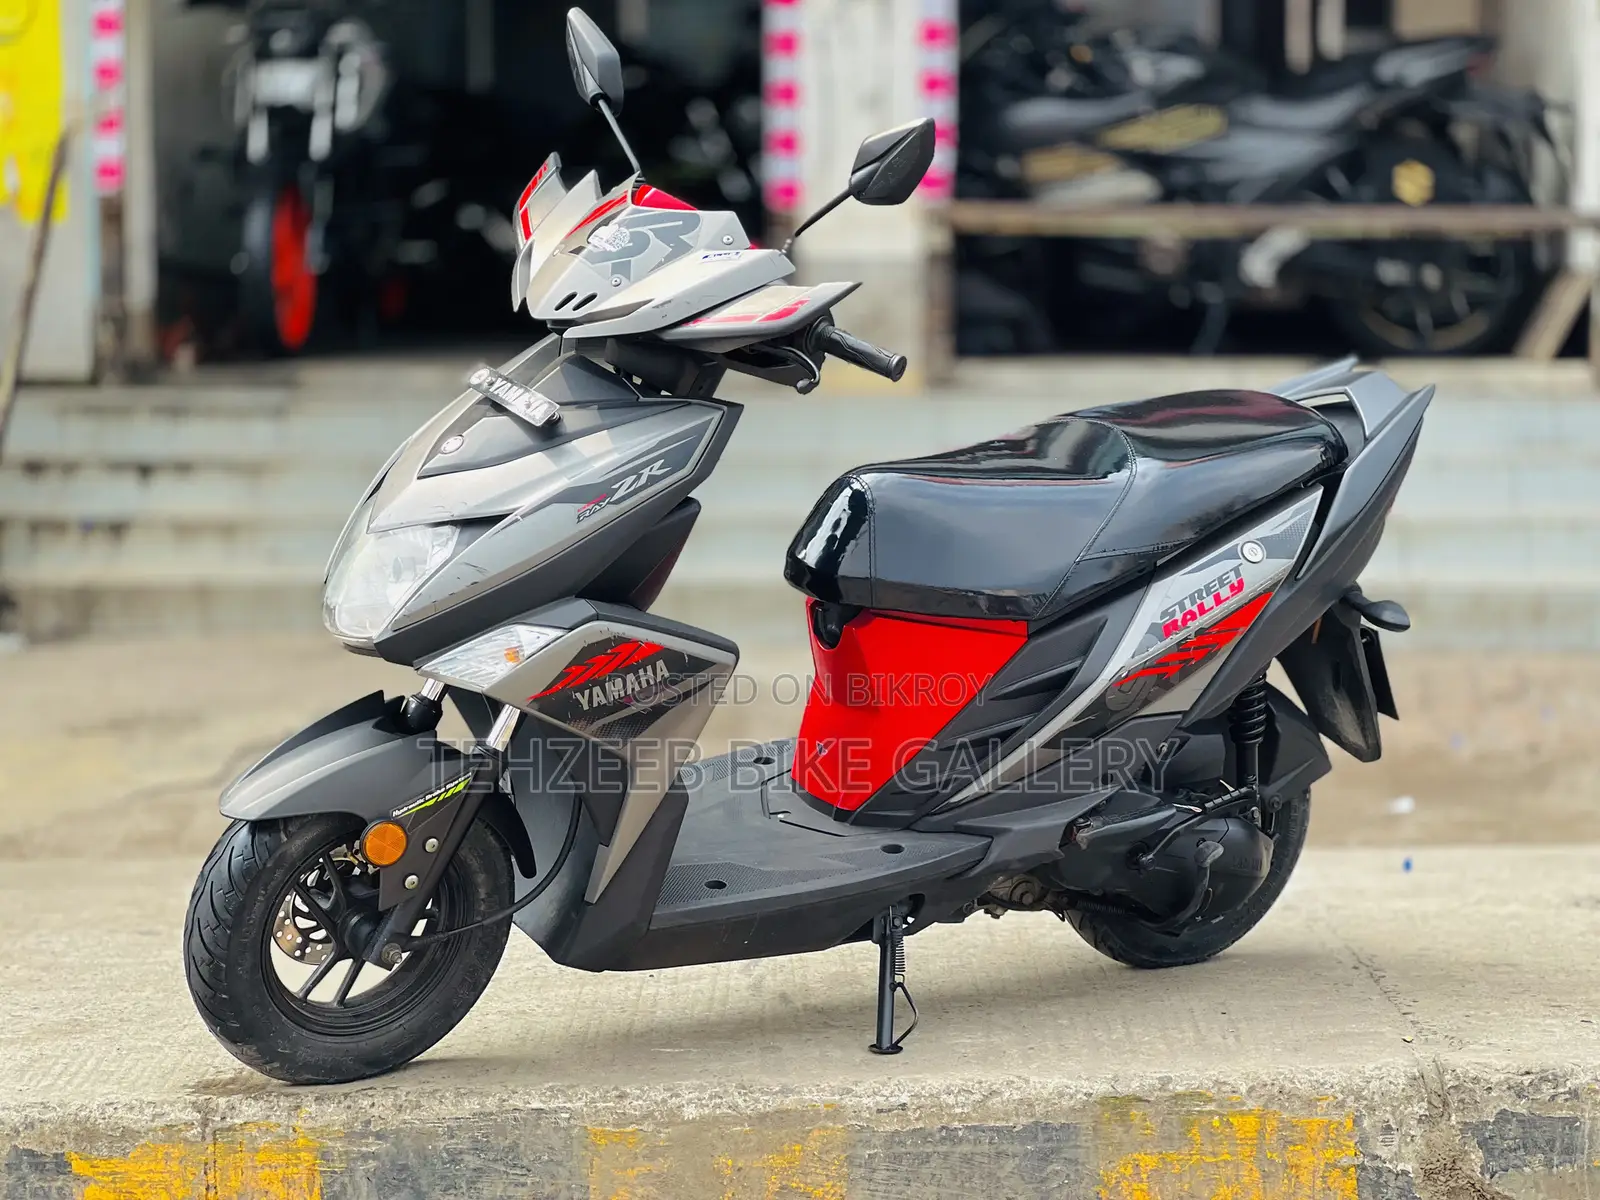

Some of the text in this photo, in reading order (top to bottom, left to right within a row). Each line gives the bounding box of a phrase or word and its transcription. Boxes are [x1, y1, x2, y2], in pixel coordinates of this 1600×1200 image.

[608, 459, 672, 502] ZR
[1160, 563, 1243, 621] STREET
[1162, 577, 1245, 639] RALLY
[575, 658, 670, 712] YAMAHA
